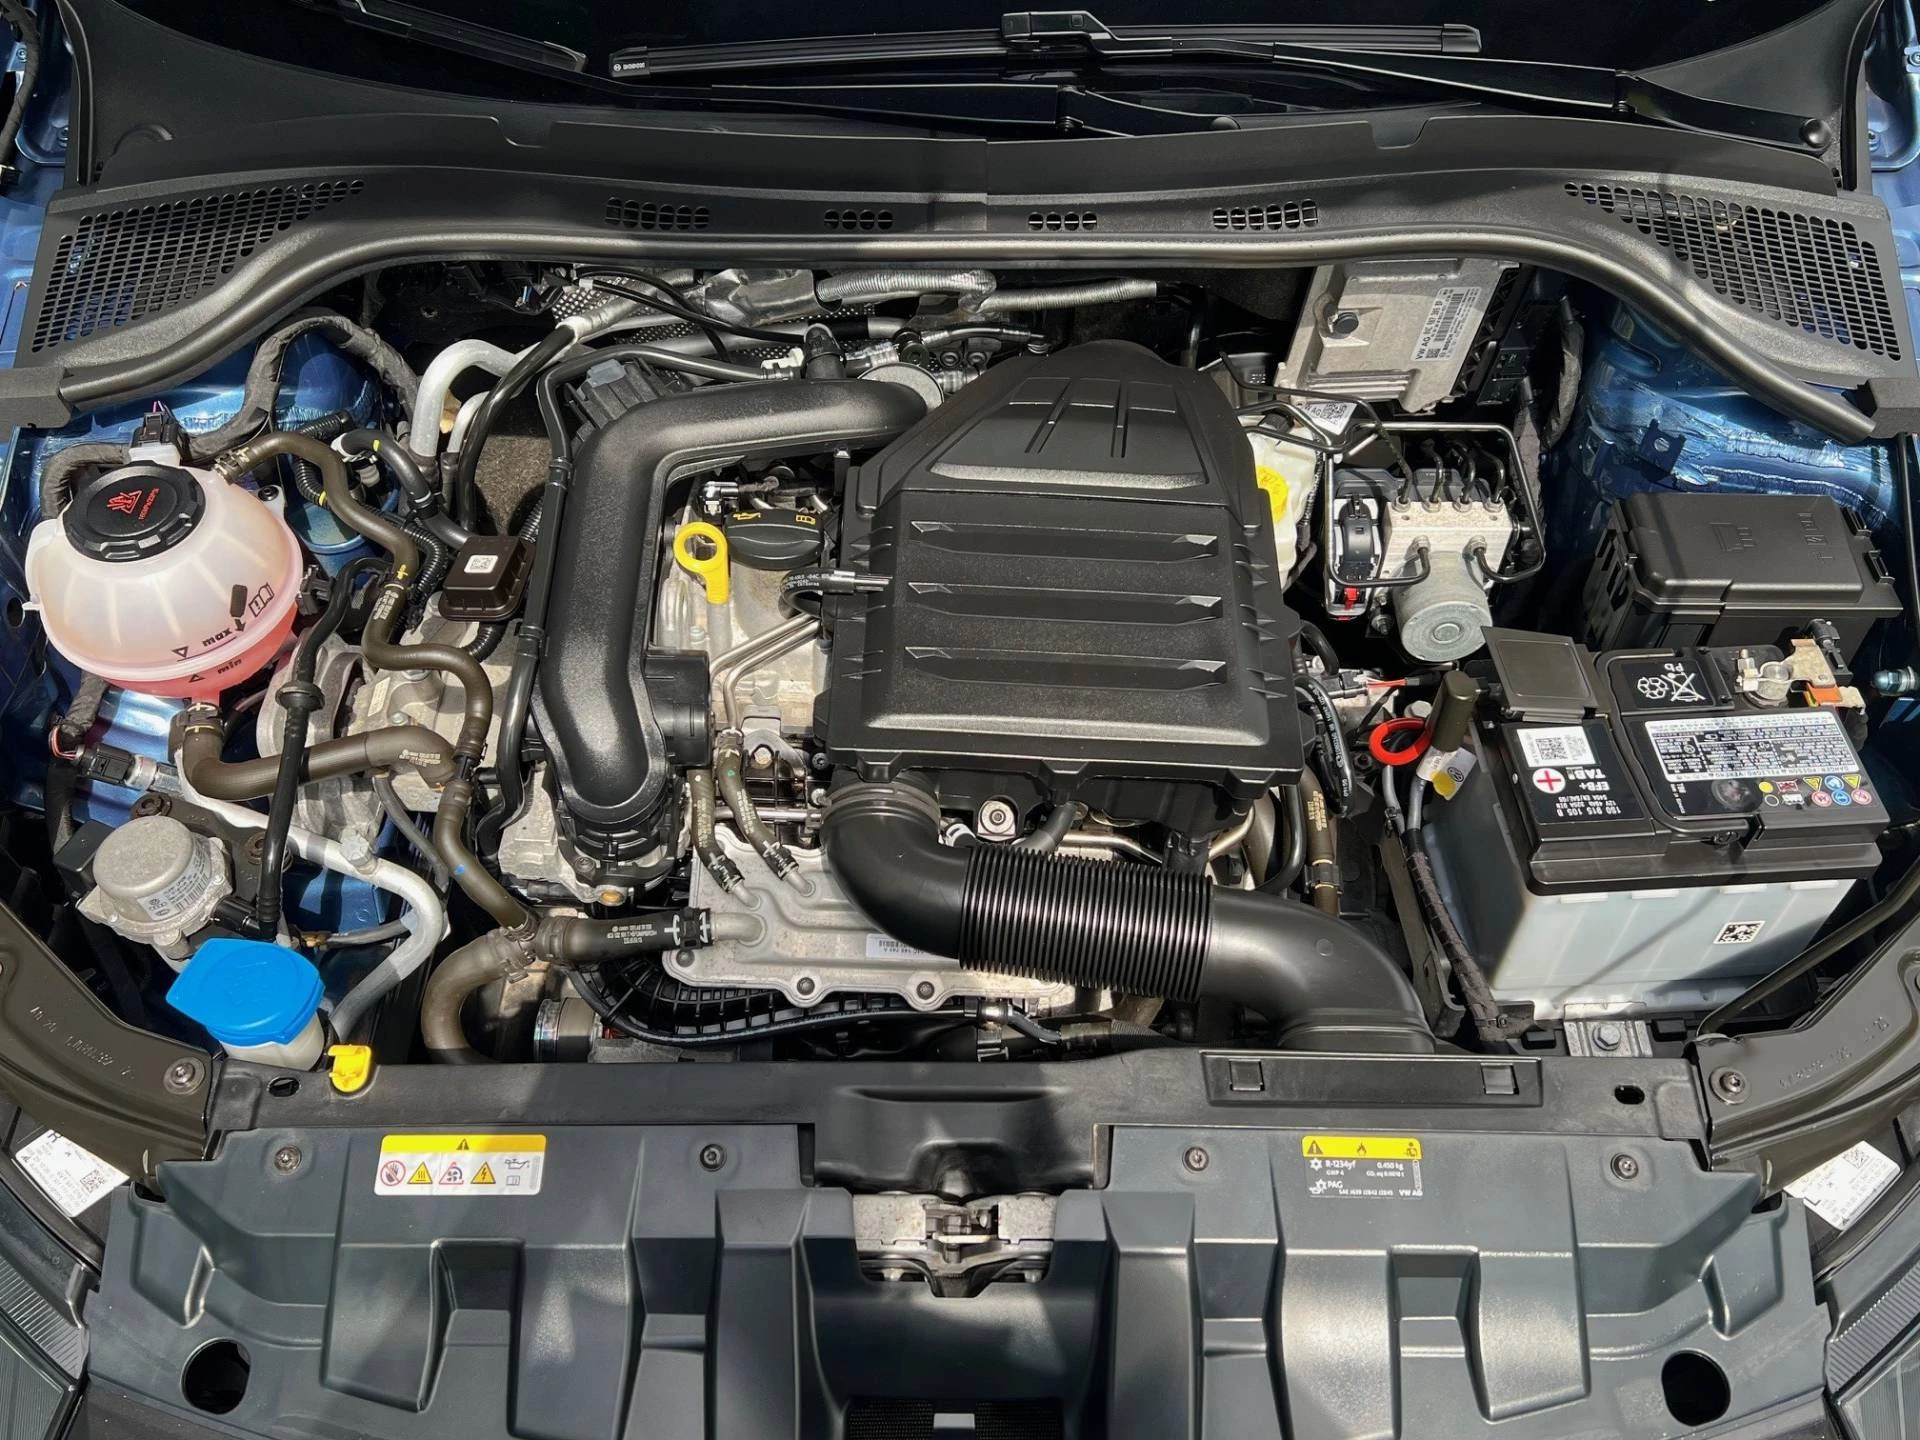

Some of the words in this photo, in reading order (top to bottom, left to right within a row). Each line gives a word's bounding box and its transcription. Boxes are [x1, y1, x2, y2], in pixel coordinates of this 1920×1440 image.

[202, 628, 232, 647] max
[217, 660, 242, 674] min
[1664, 662, 1684, 672] Pb
[1579, 782, 1610, 791] EFB+
[1567, 808, 1583, 816] 105
[1587, 807, 1603, 816] 915
[1326, 1160, 1356, 1170] R-1234yf
[1396, 1162, 1404, 1170] kg
[1328, 1180, 1344, 1188] PAG
